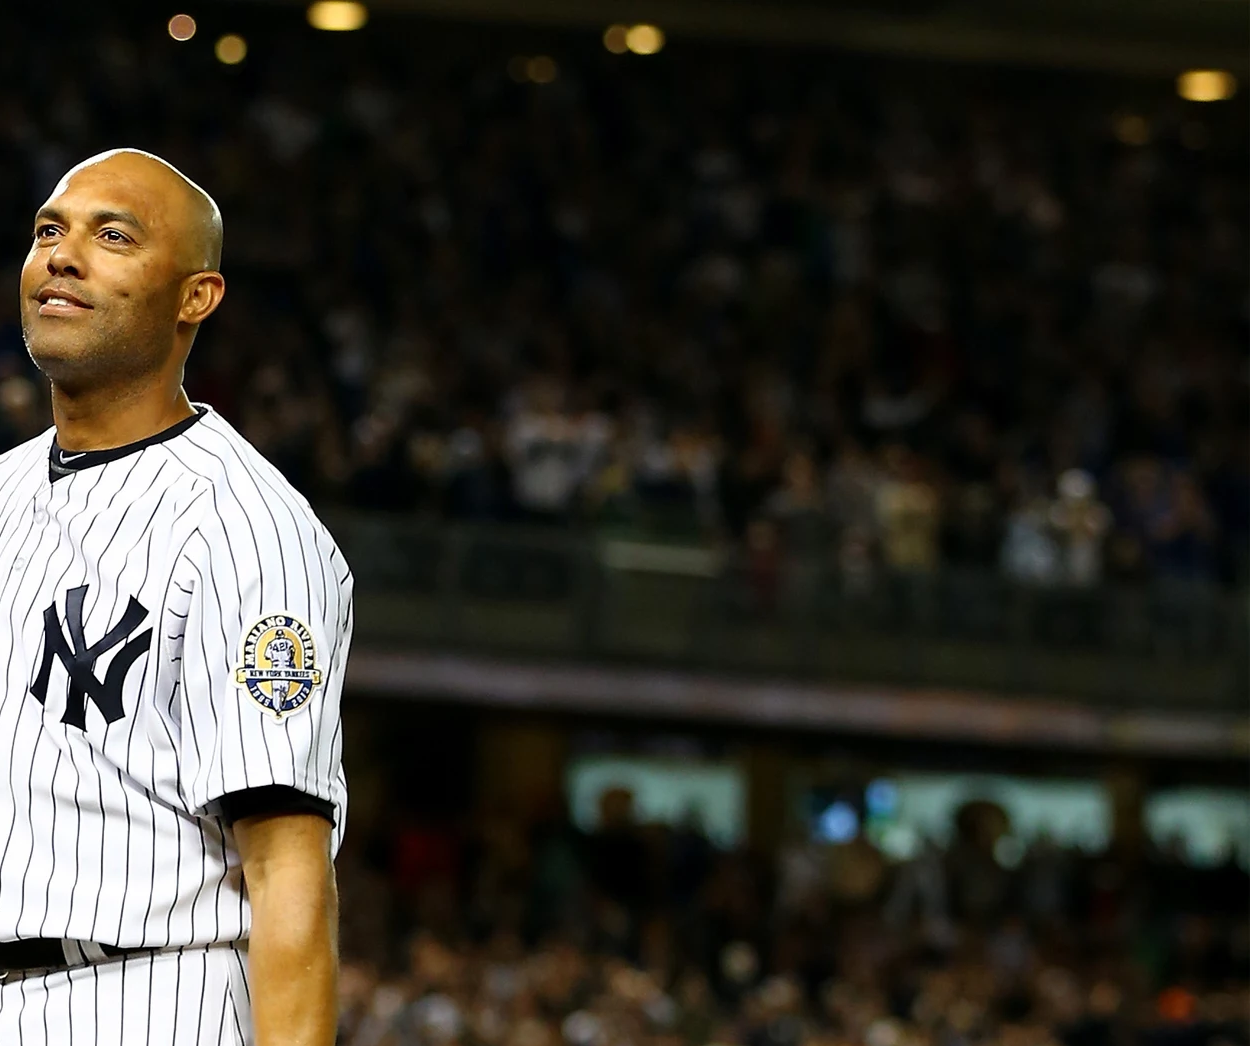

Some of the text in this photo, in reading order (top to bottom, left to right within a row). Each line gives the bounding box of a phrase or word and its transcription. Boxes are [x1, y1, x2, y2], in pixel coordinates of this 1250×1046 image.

[30, 583, 153, 732] NY
[245, 616, 314, 667] MARIANO RIVERA
[249, 670, 310, 678] NEW YORK YANKEES
[292, 687, 310, 707] 2013
